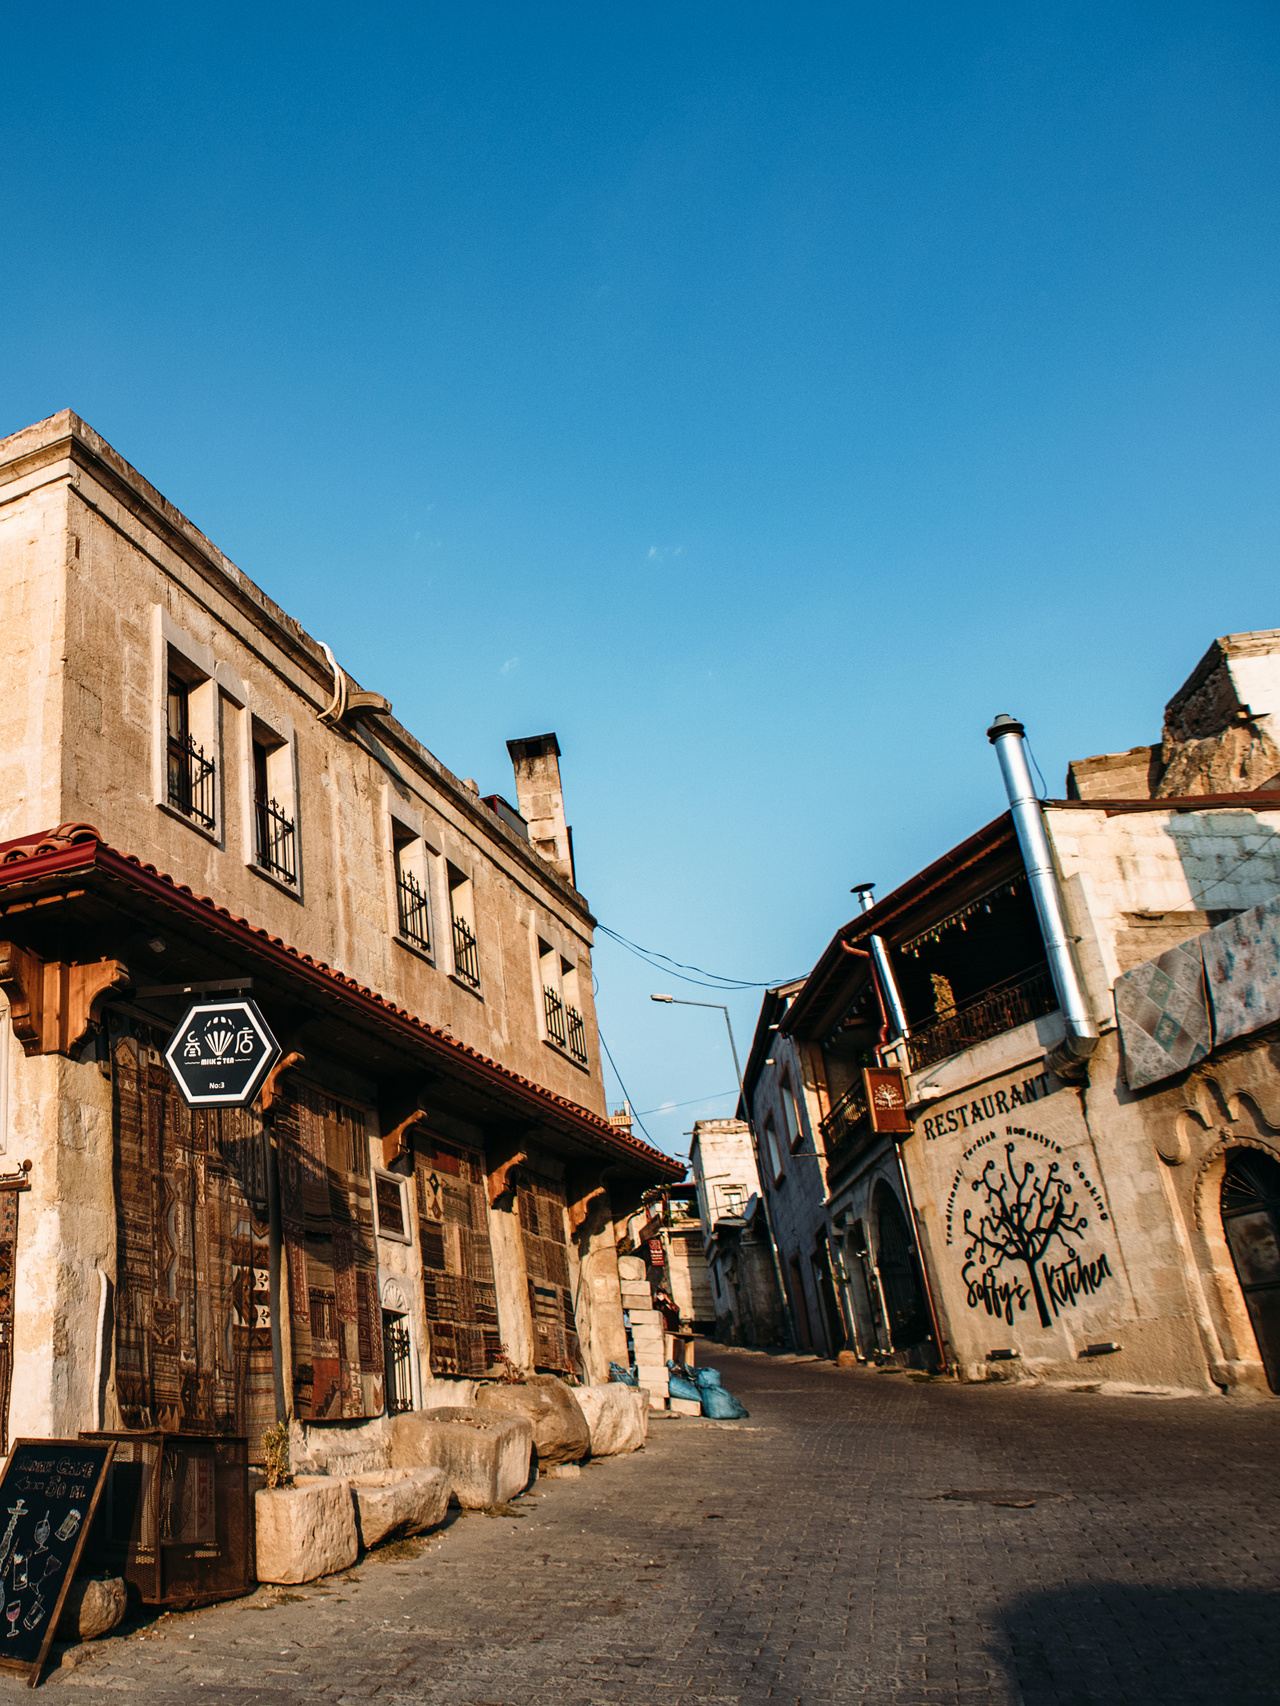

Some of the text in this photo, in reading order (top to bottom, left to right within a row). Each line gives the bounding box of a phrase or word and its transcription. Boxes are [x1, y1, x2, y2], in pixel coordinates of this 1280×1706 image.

[201, 1056, 235, 1066] MILK TEA
[208, 1081, 225, 1090] No:3
[922, 1071, 1050, 1141] RESTAURANT
[945, 1125, 1109, 1246] Traditional Turkish Homestyle Cooking
[1042, 1253, 1113, 1318] Kitchen
